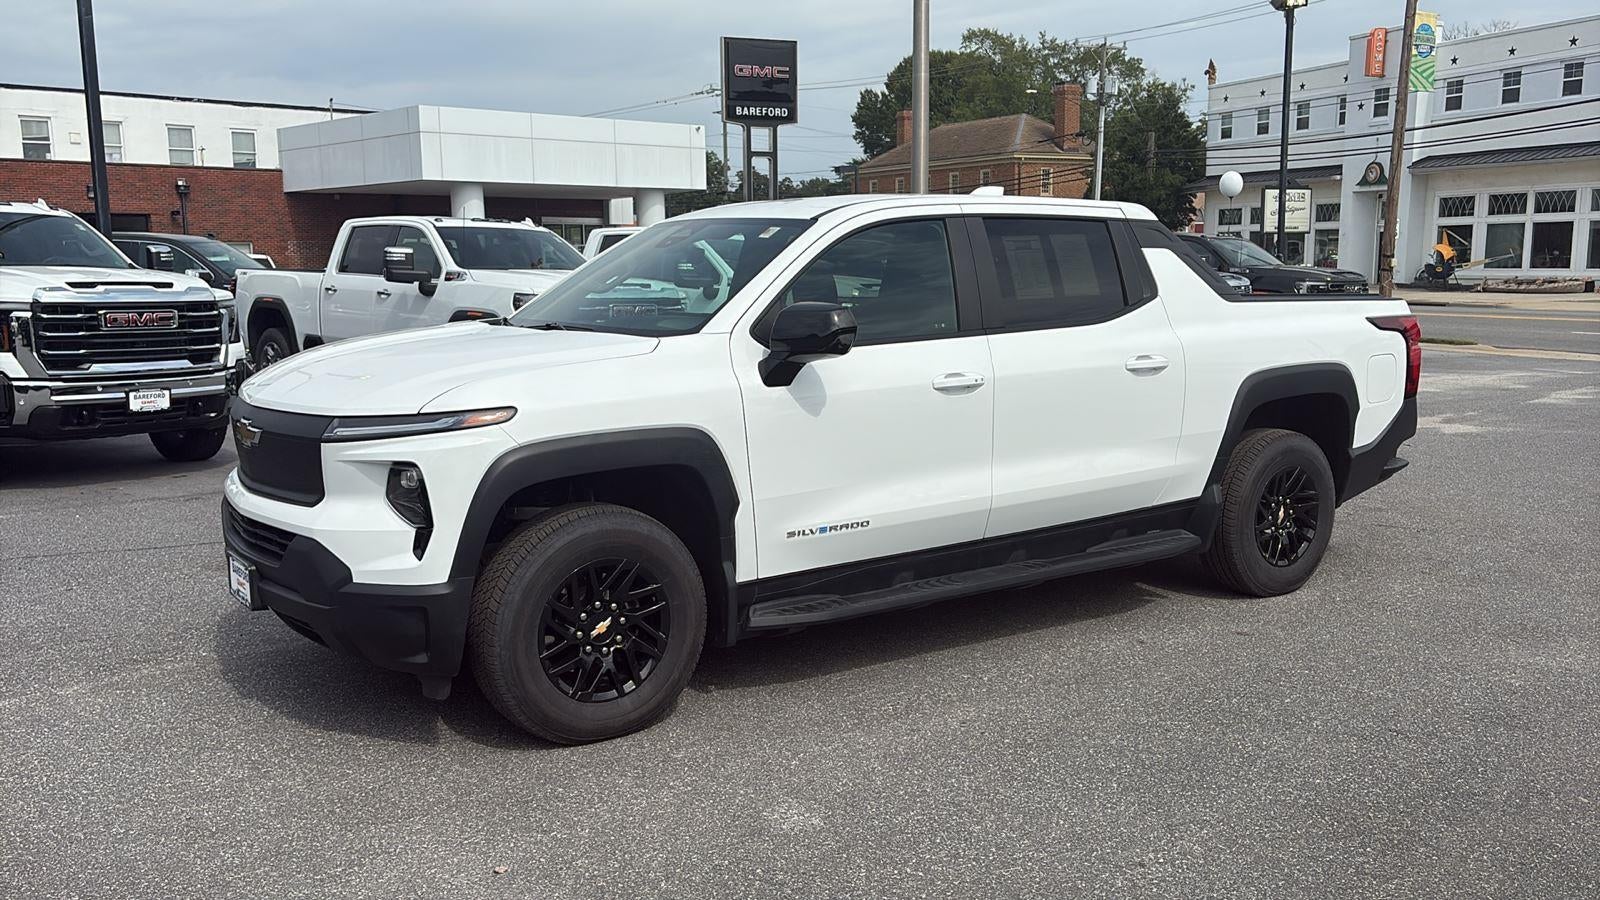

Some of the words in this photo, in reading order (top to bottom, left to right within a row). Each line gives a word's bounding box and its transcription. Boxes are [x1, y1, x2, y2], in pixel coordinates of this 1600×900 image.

[1375, 31, 1383, 73] ACME
[734, 64, 789, 79] GMC
[735, 106, 788, 117] BAREFORD
[106, 313, 174, 327] GMC
[133, 392, 166, 400] BAREFORD
[786, 520, 870, 539] SILVERADO
